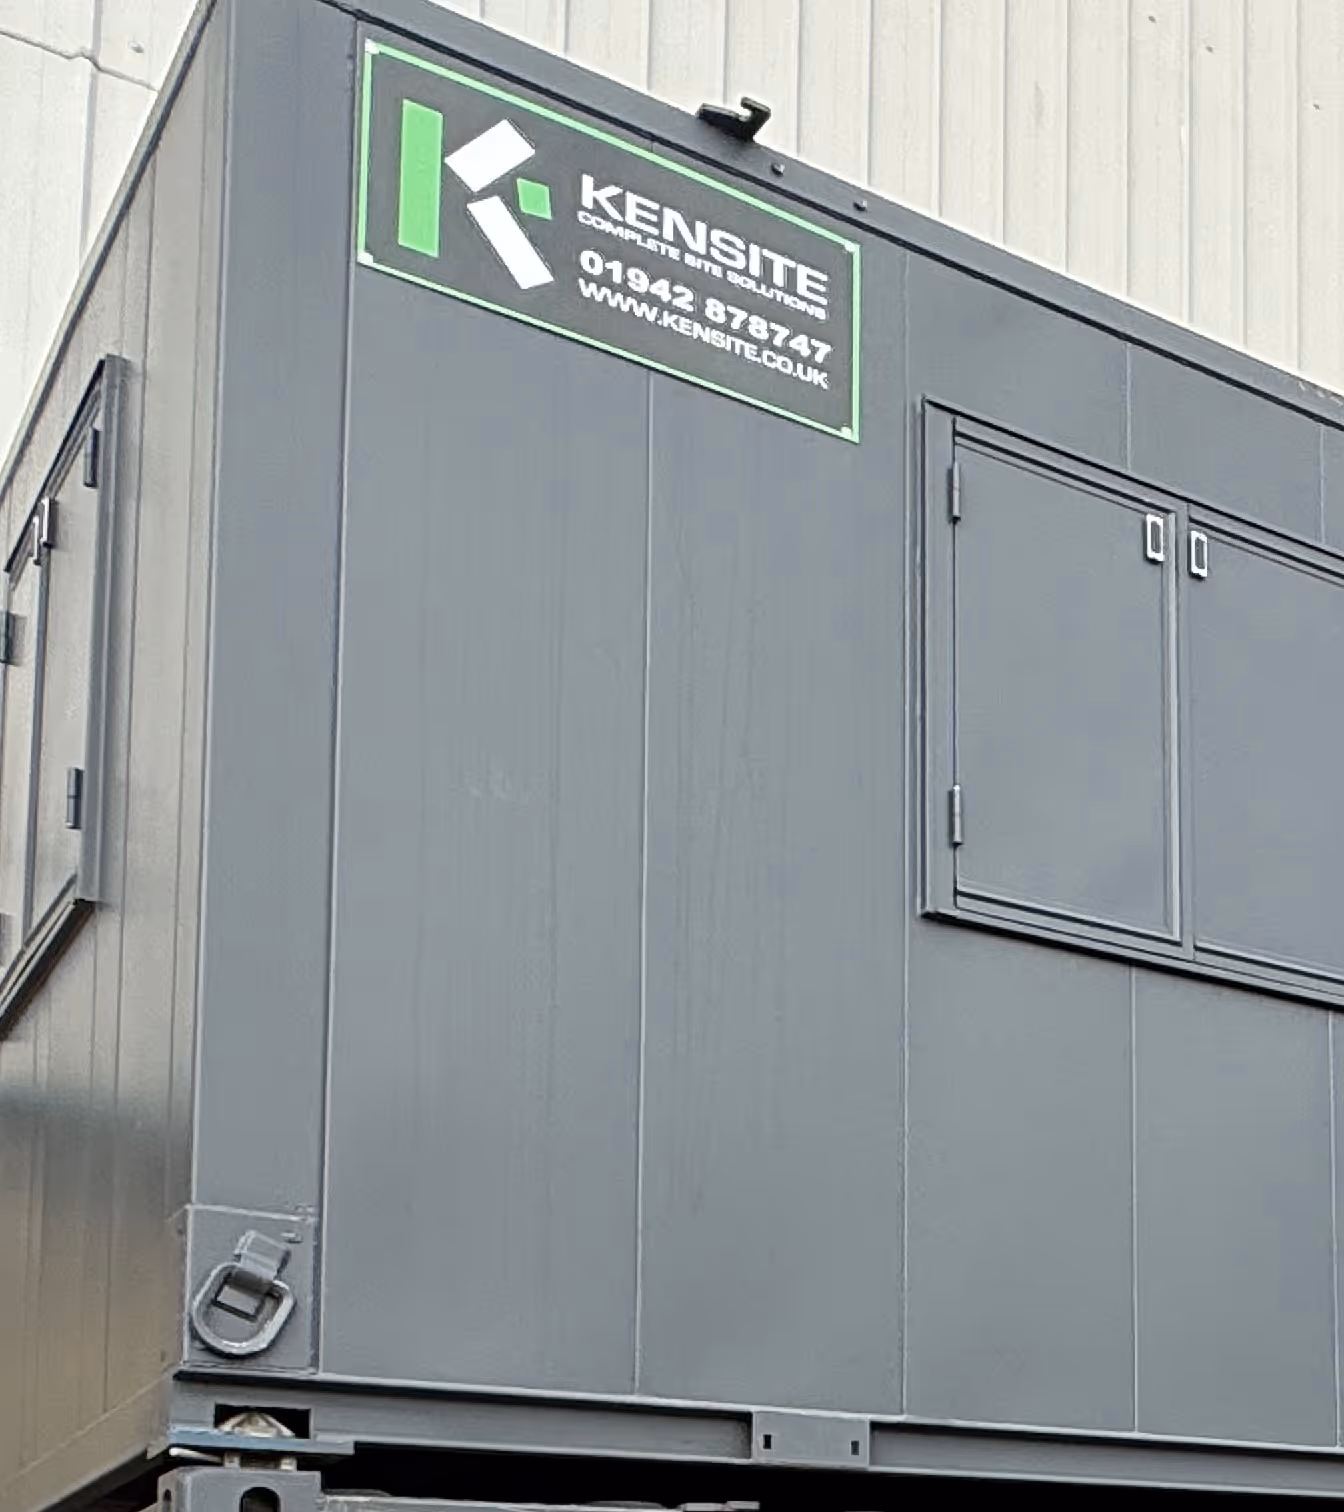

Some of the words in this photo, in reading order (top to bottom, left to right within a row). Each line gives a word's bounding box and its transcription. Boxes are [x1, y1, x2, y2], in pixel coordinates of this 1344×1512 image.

[577, 210, 681, 261] COMPLETE
[684, 252, 723, 278] SITE
[726, 269, 827, 321] SOLUTIONS
[581, 173, 829, 305] KENSITE
[578, 277, 829, 389] WWW.KENSITE.CO.UK
[579, 249, 695, 312] 01942
[704, 298, 832, 364] 878747
